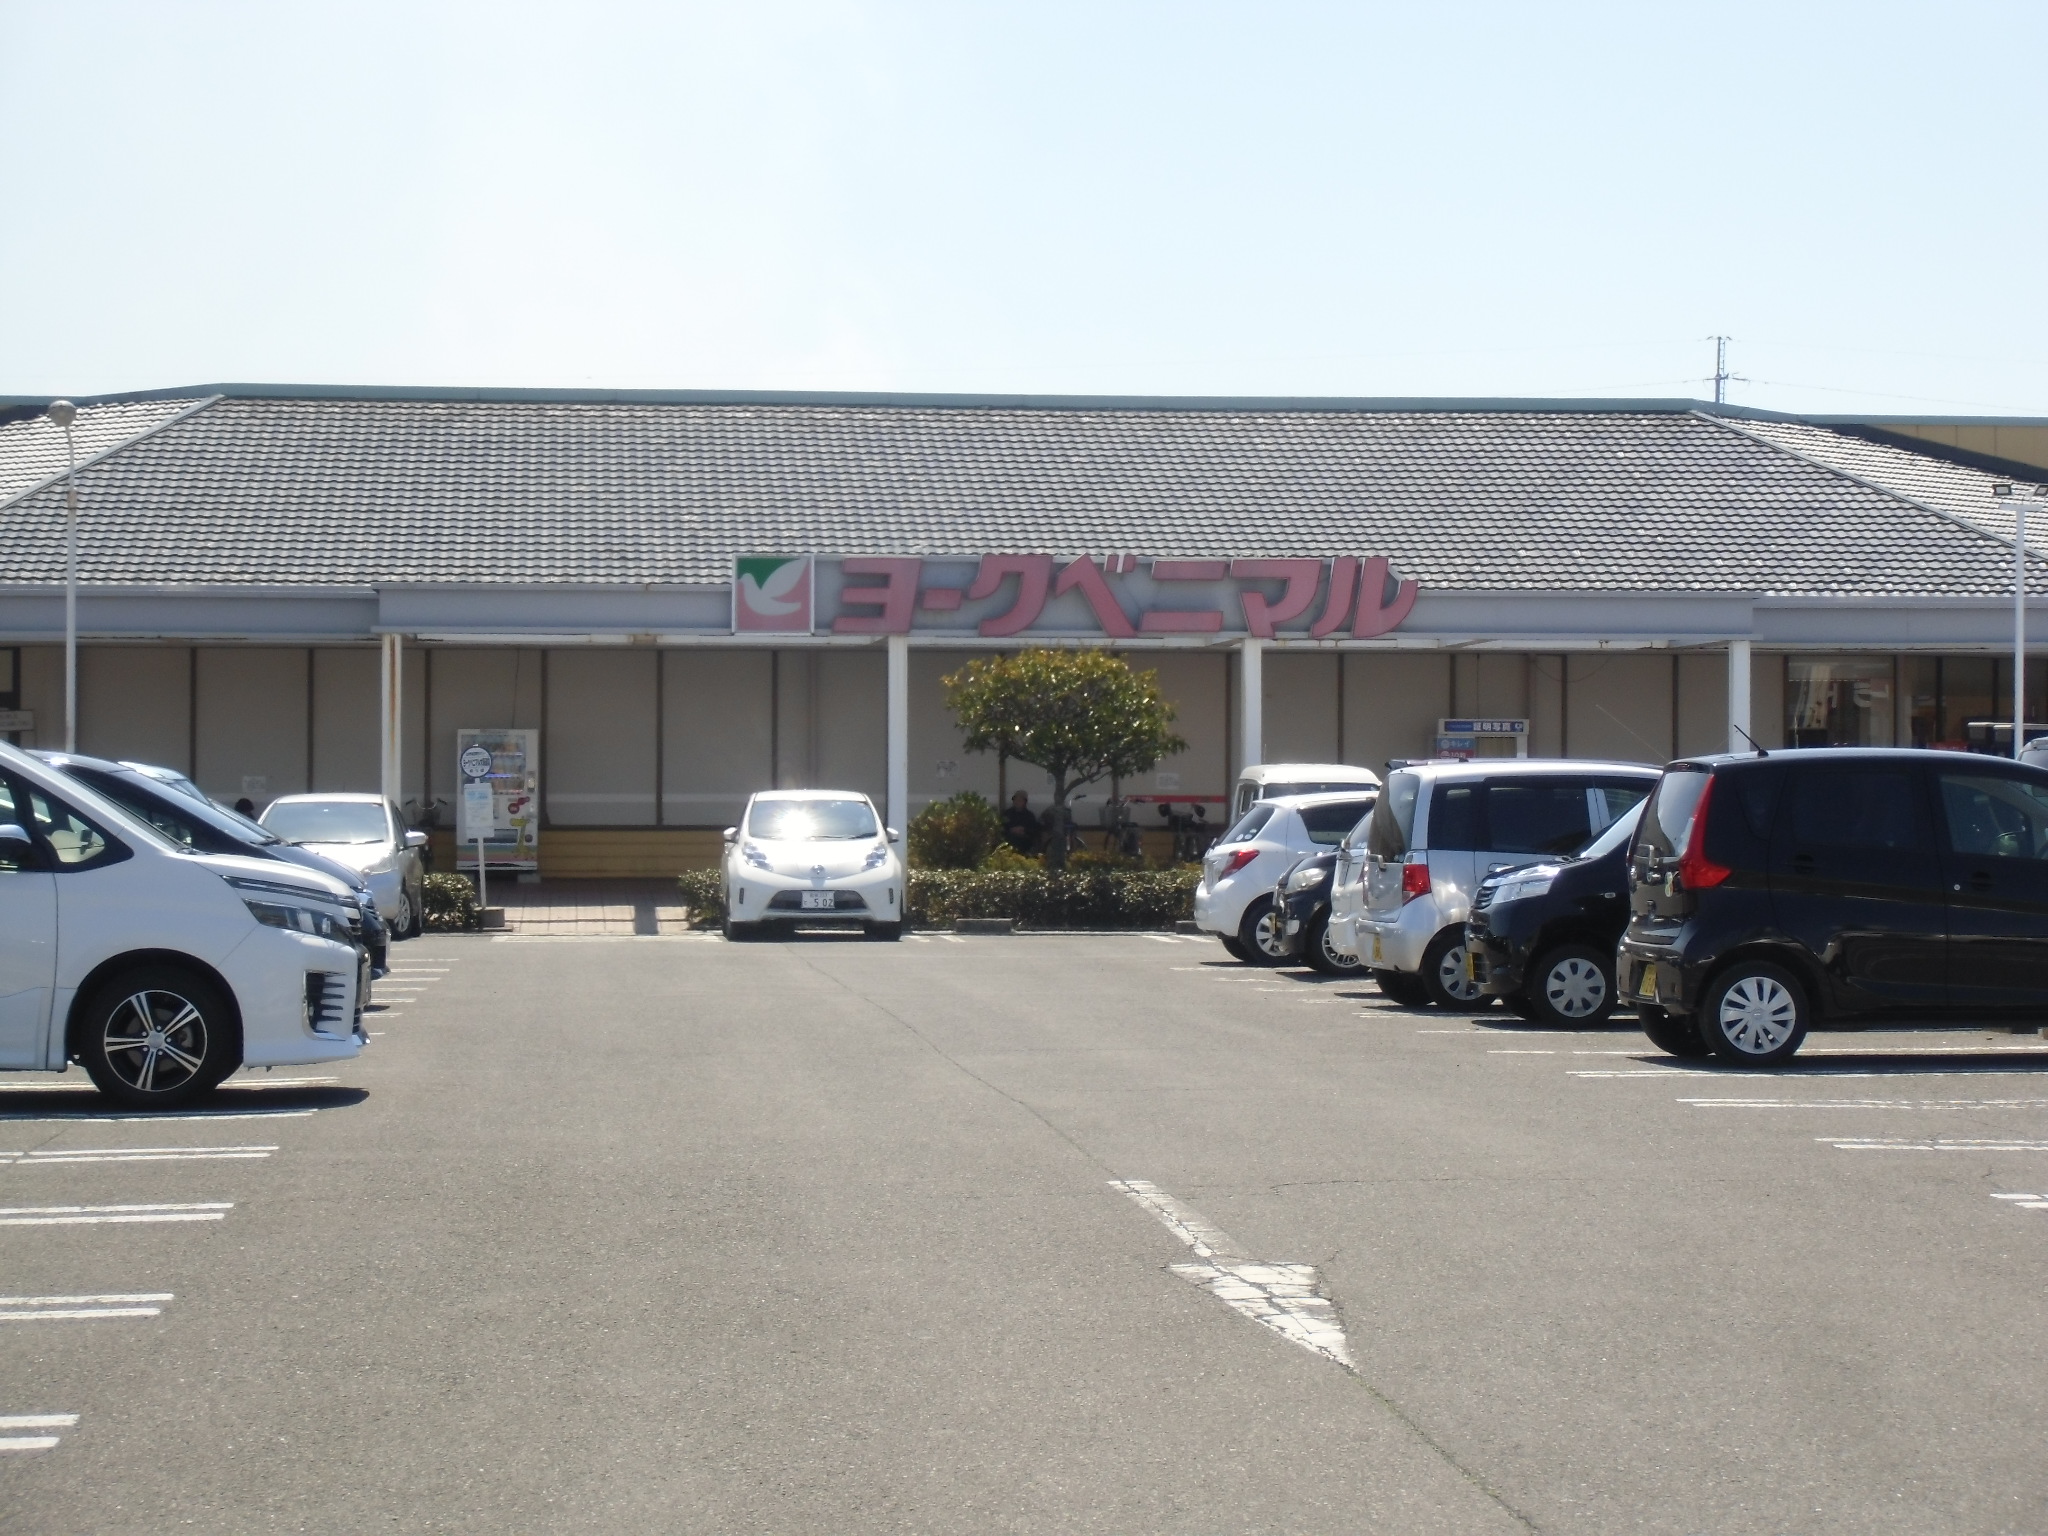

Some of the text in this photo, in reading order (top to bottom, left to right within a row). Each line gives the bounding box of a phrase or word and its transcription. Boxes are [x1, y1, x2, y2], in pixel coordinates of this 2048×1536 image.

[832, 553, 1419, 639] ヨークベニマル
